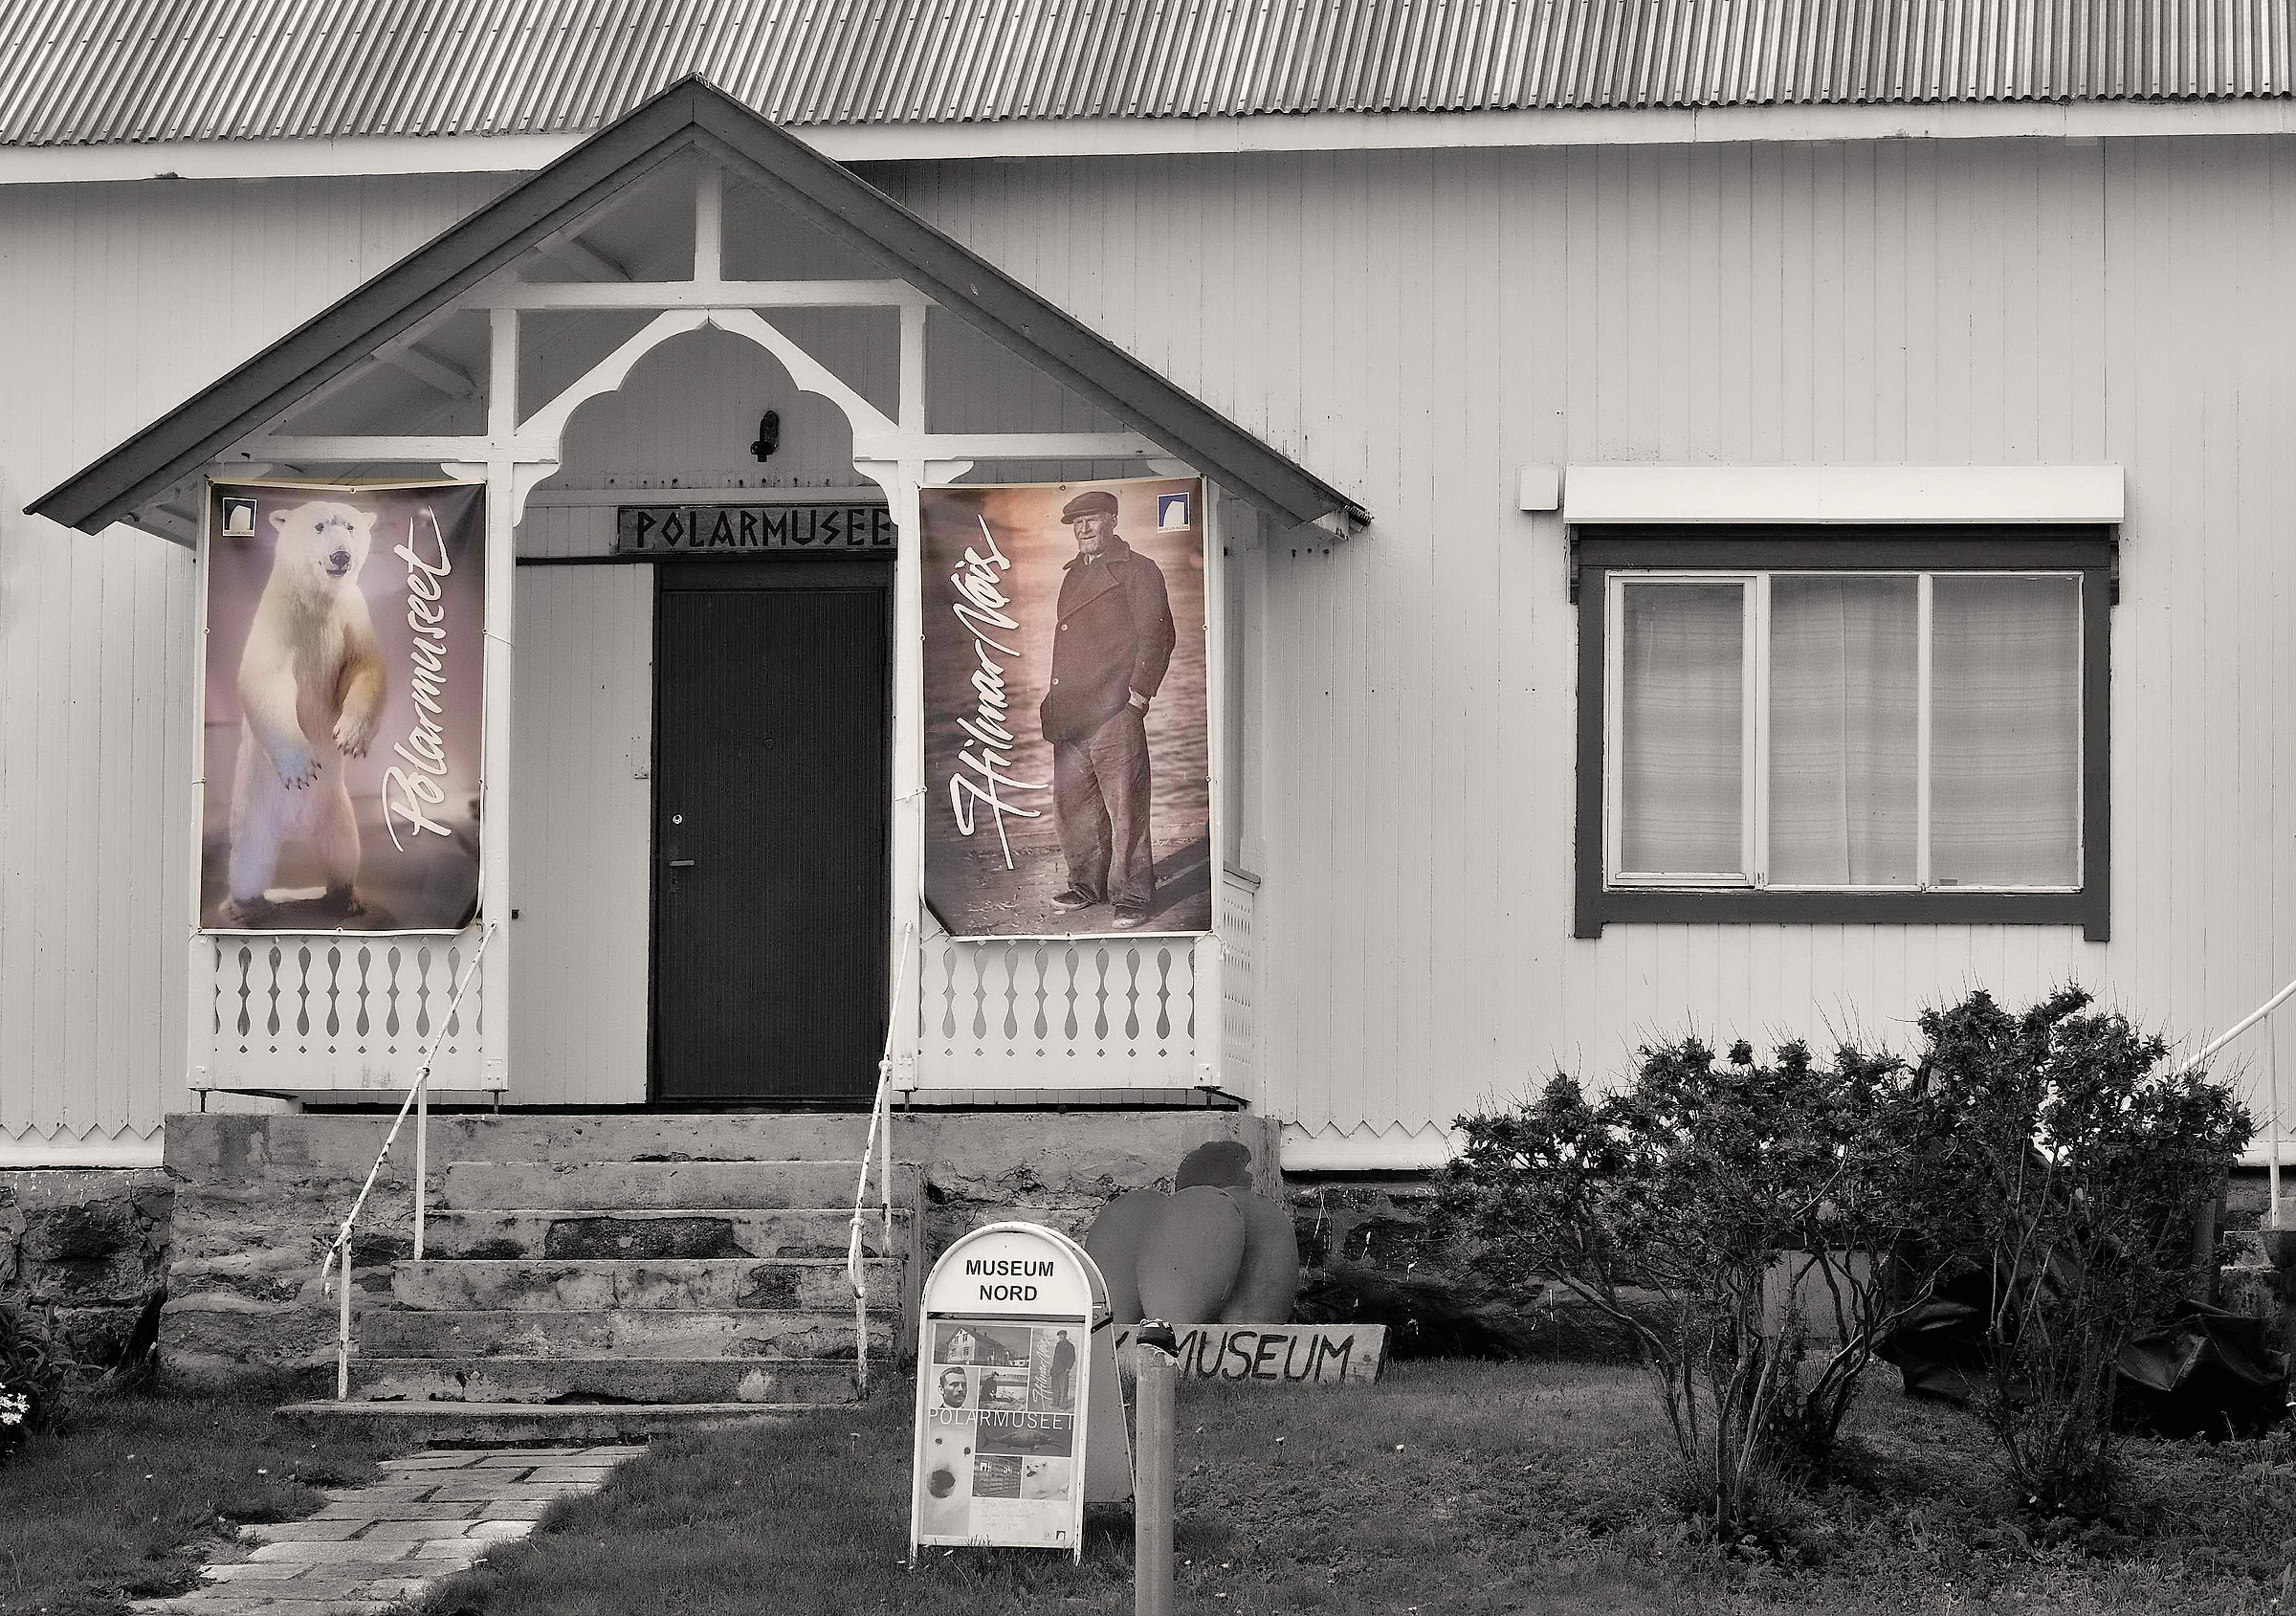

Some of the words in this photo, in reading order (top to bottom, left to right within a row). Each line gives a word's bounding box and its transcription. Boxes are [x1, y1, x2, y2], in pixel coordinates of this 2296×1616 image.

[637, 510, 891, 548] POLARMUSEE
[382, 506, 453, 852] Polarmuseet
[950, 638, 1049, 870] Hilmar
[965, 1259, 1054, 1278] MUSEUM
[980, 1285, 1039, 1302] NORD
[929, 1409, 1073, 1431] POLARMUSEET
